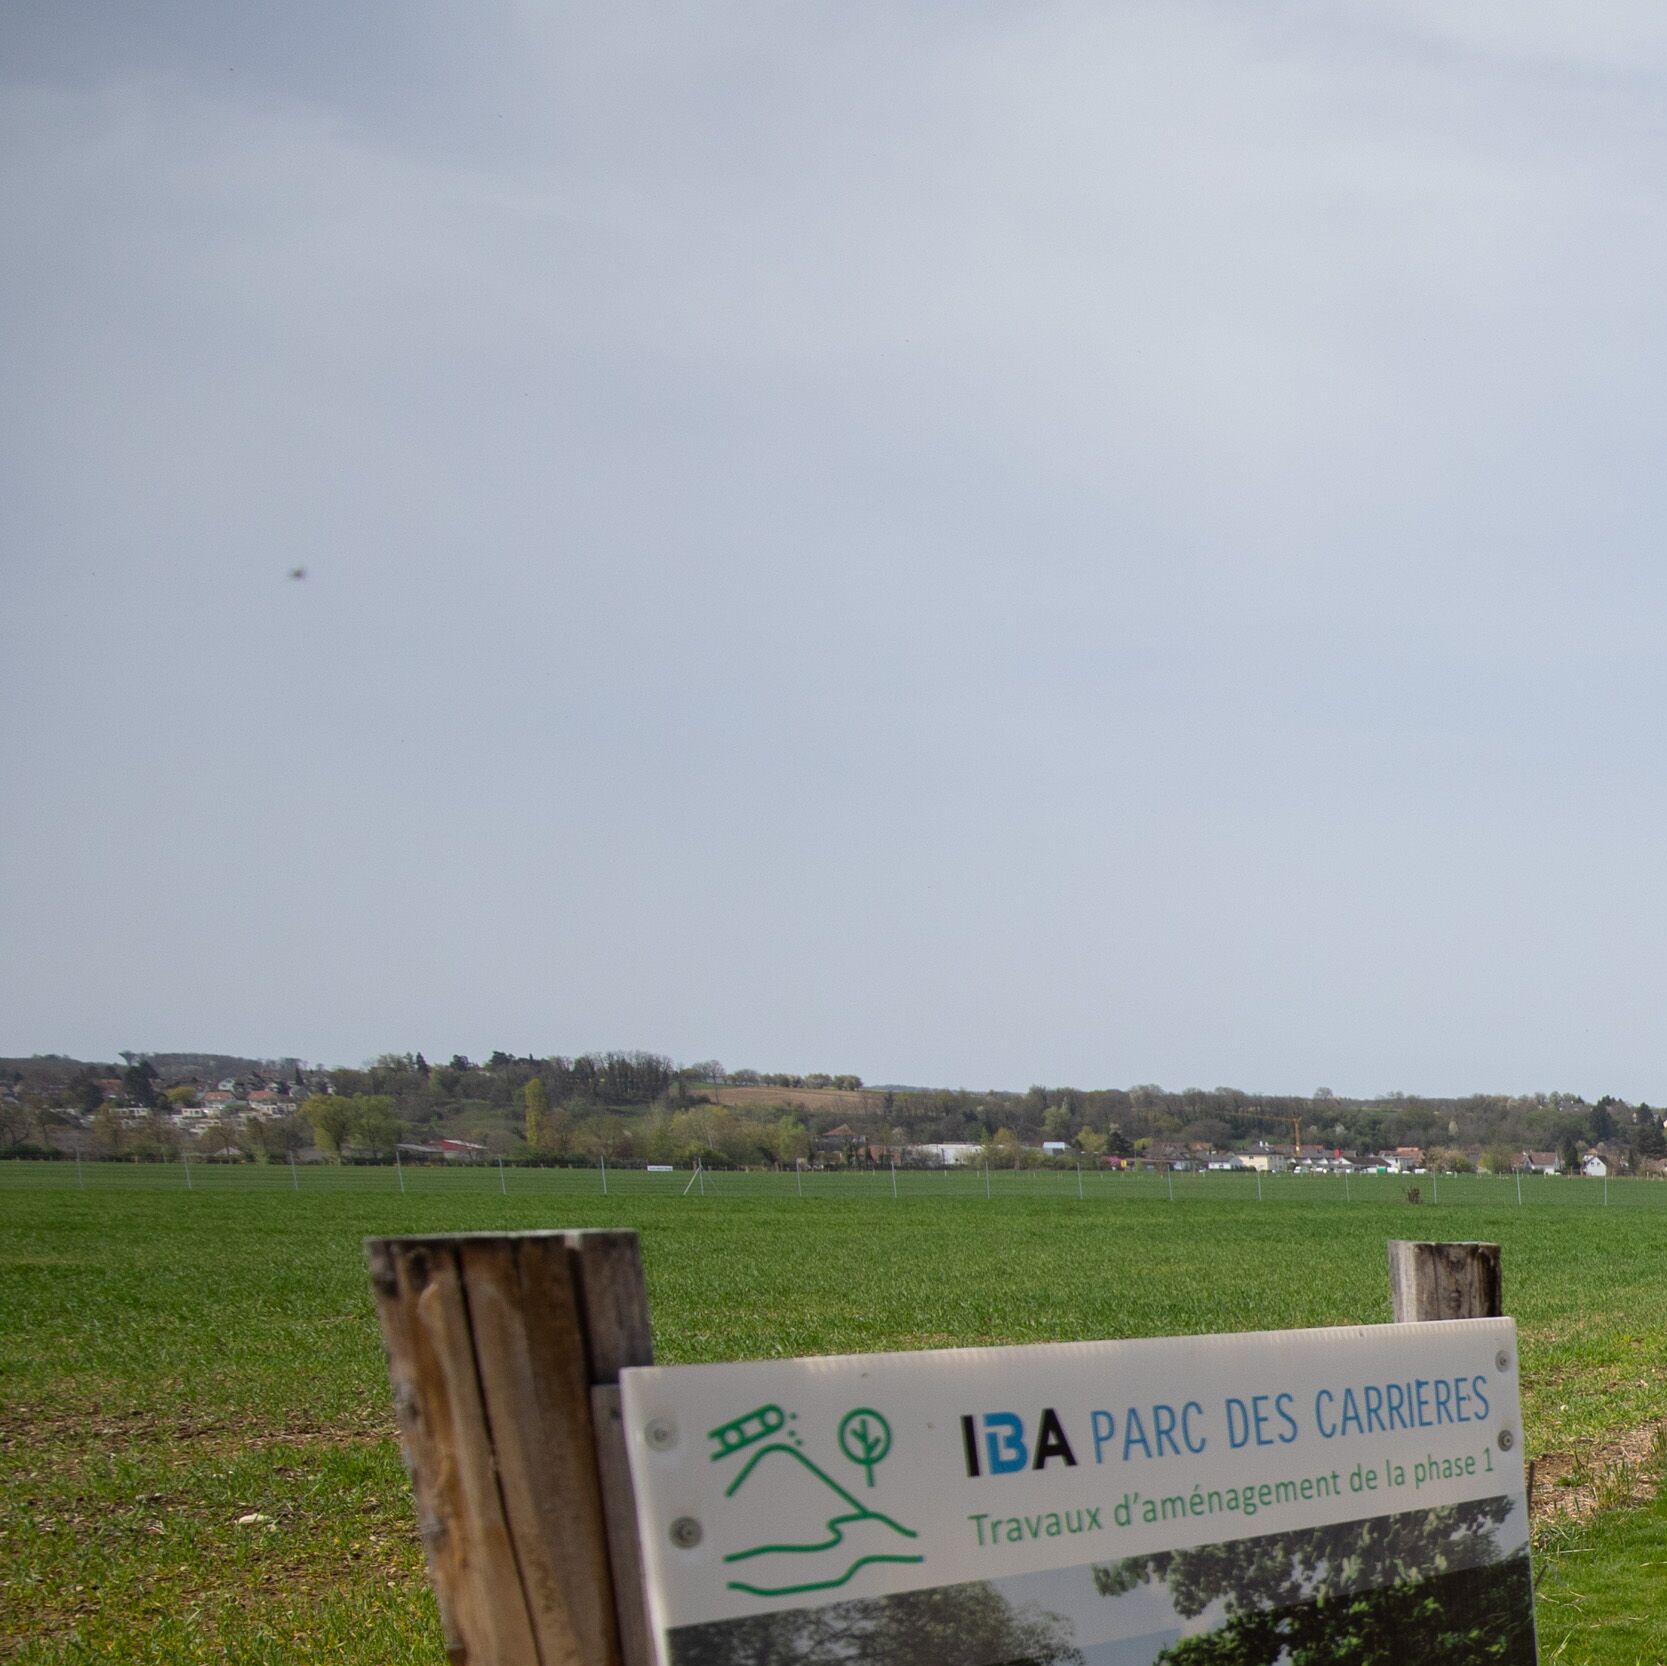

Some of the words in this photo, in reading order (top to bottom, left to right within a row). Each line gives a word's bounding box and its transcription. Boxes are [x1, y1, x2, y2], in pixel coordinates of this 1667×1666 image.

[960, 1407, 1078, 1478] IBA
[1090, 1401, 1207, 1465] PARC
[1224, 1393, 1298, 1449] DES
[1315, 1375, 1489, 1439] CARRIÈRES
[967, 1505, 1102, 1546] Travaux
[1114, 1470, 1341, 1527] d'aménagement
[1350, 1463, 1377, 1492] de
[1386, 1459, 1405, 1488] la
[1414, 1454, 1476, 1489] phase
[1483, 1447, 1493, 1472] 1
